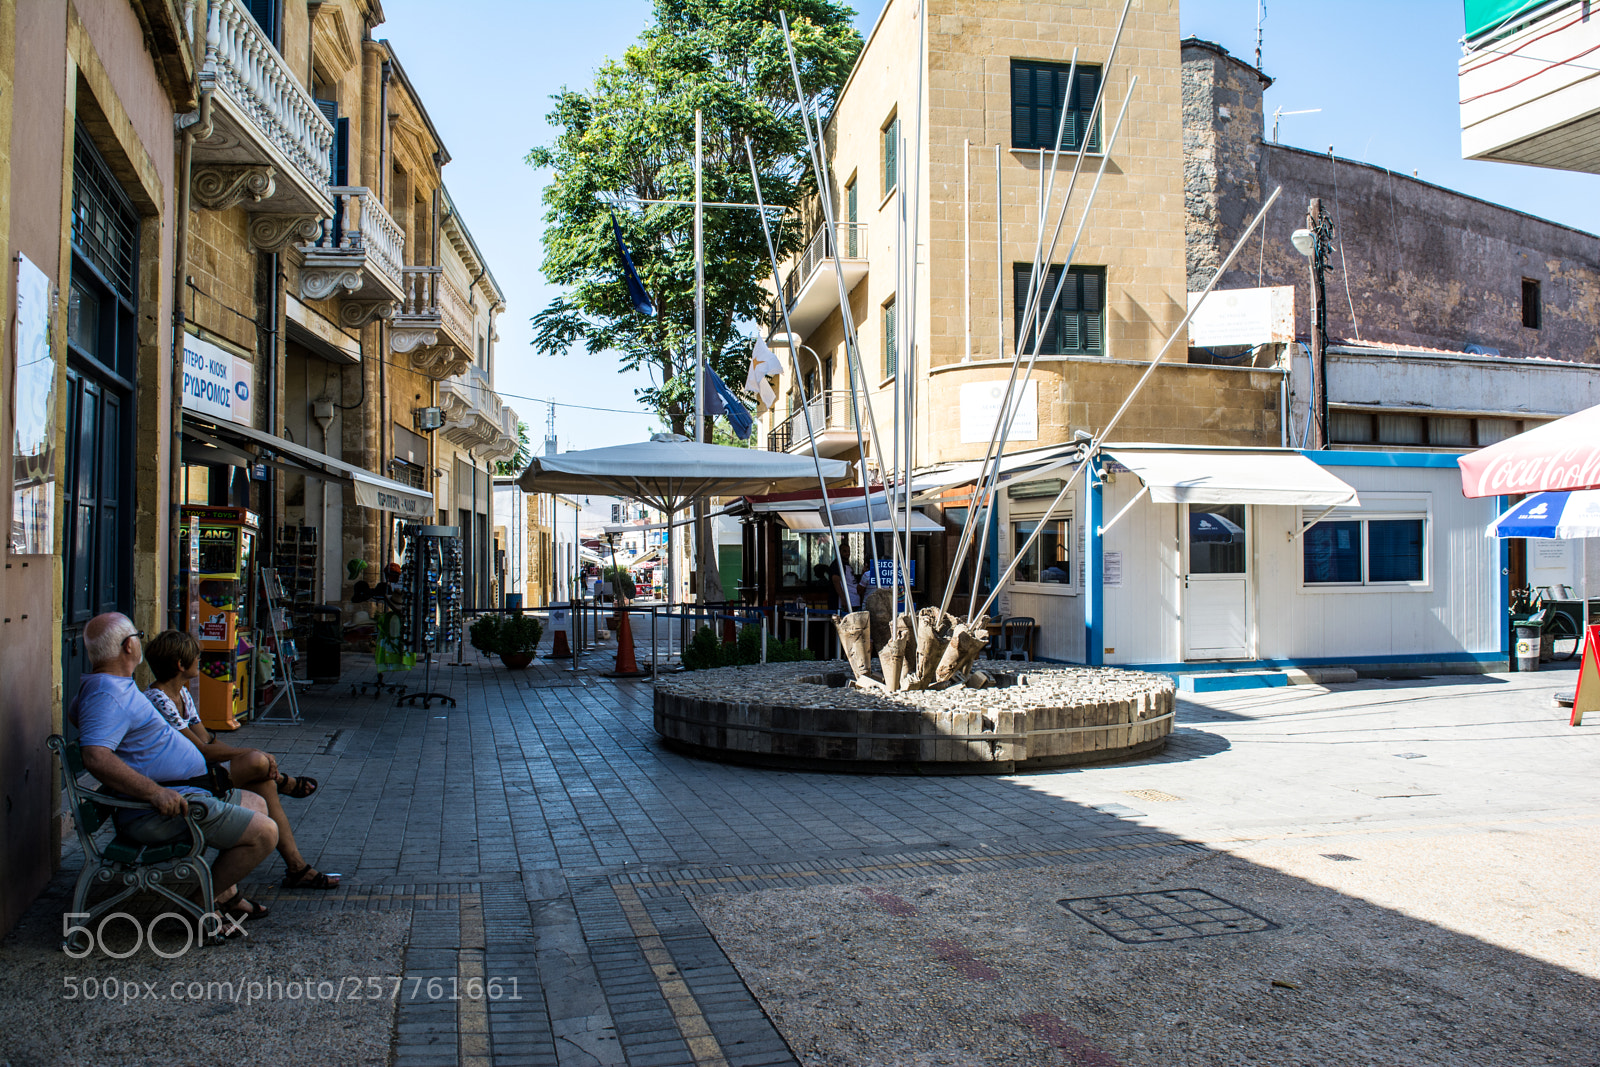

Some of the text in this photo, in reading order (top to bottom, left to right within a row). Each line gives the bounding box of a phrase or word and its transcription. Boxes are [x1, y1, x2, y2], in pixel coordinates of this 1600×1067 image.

[209, 358, 228, 380] KIOSK
[182, 372, 231, 408] ΡΥΔΡΟΜΟΣ
[213, 511, 233, 519] TOYS
